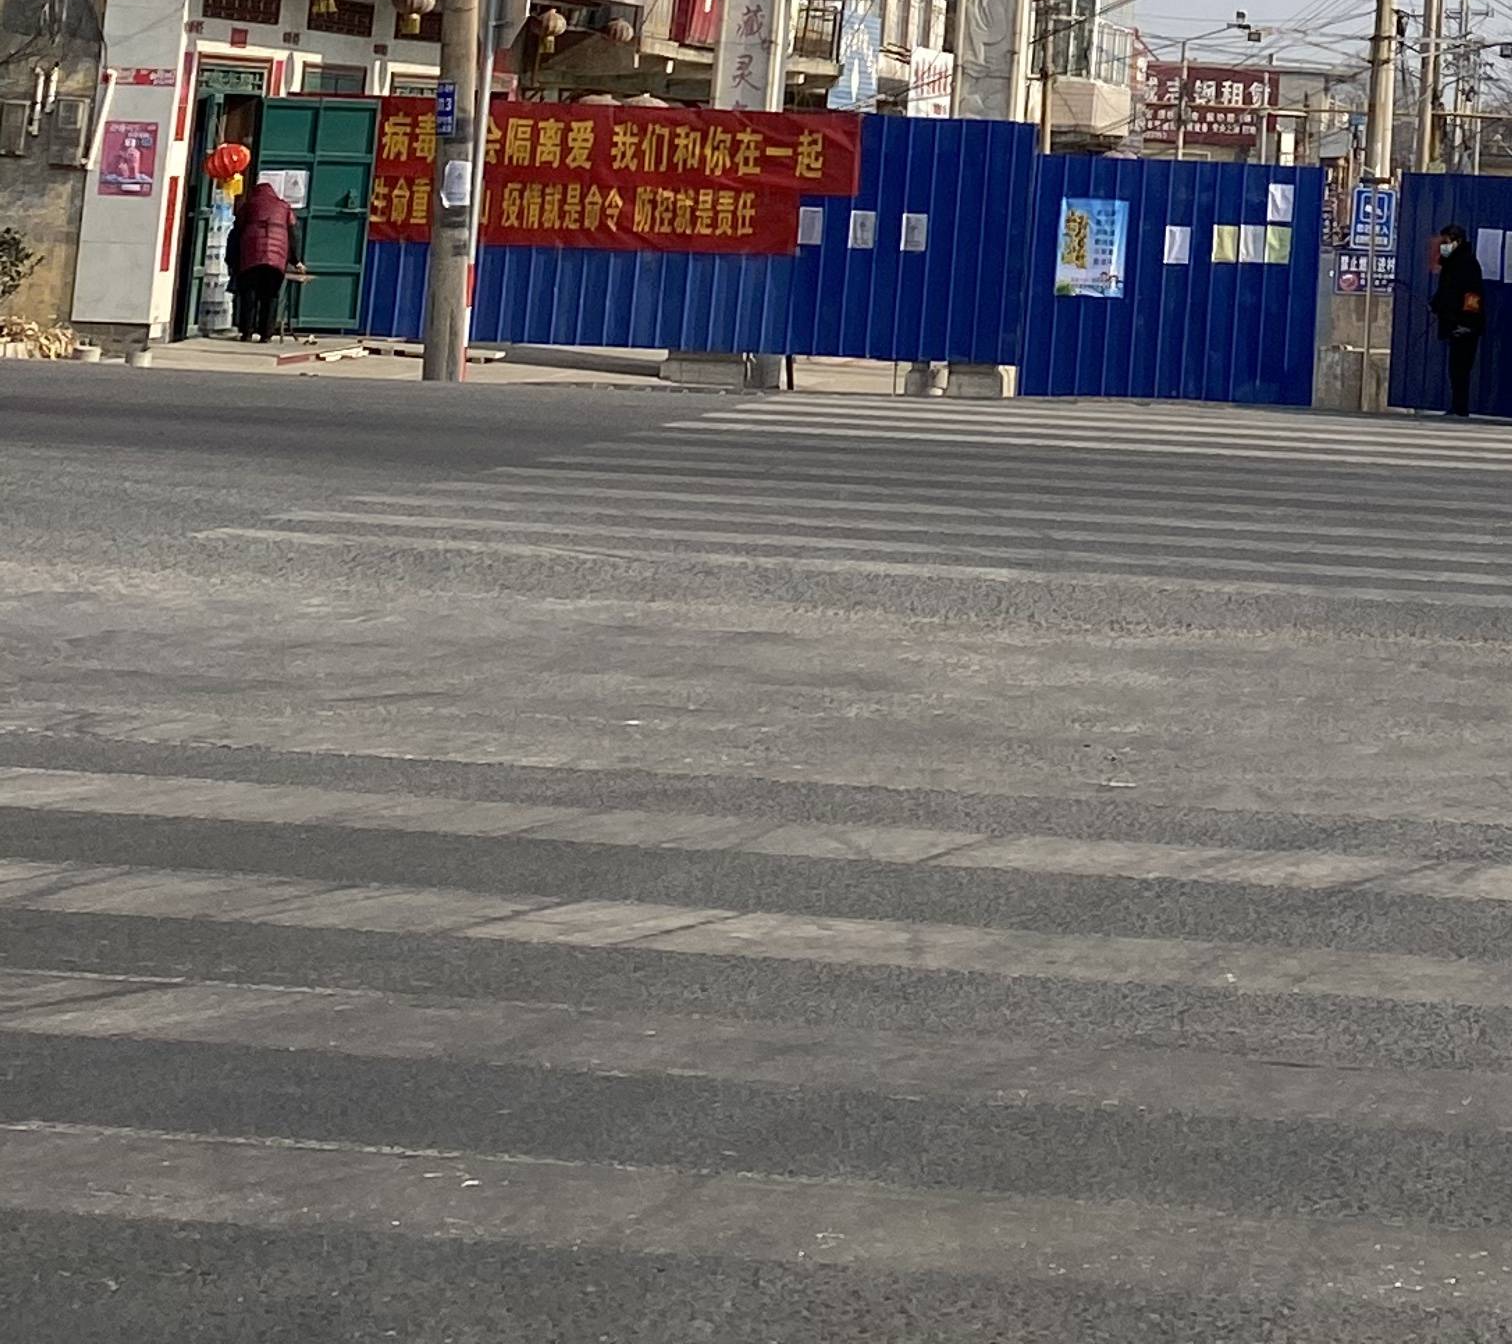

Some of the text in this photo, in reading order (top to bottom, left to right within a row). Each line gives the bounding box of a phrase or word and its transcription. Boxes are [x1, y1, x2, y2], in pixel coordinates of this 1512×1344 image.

[381, 112, 824, 179] 病毒会隔离爱 我们和你在一起
[501, 180, 624, 234] 疫情就是命令
[632, 184, 756, 236] 防控就是责任
